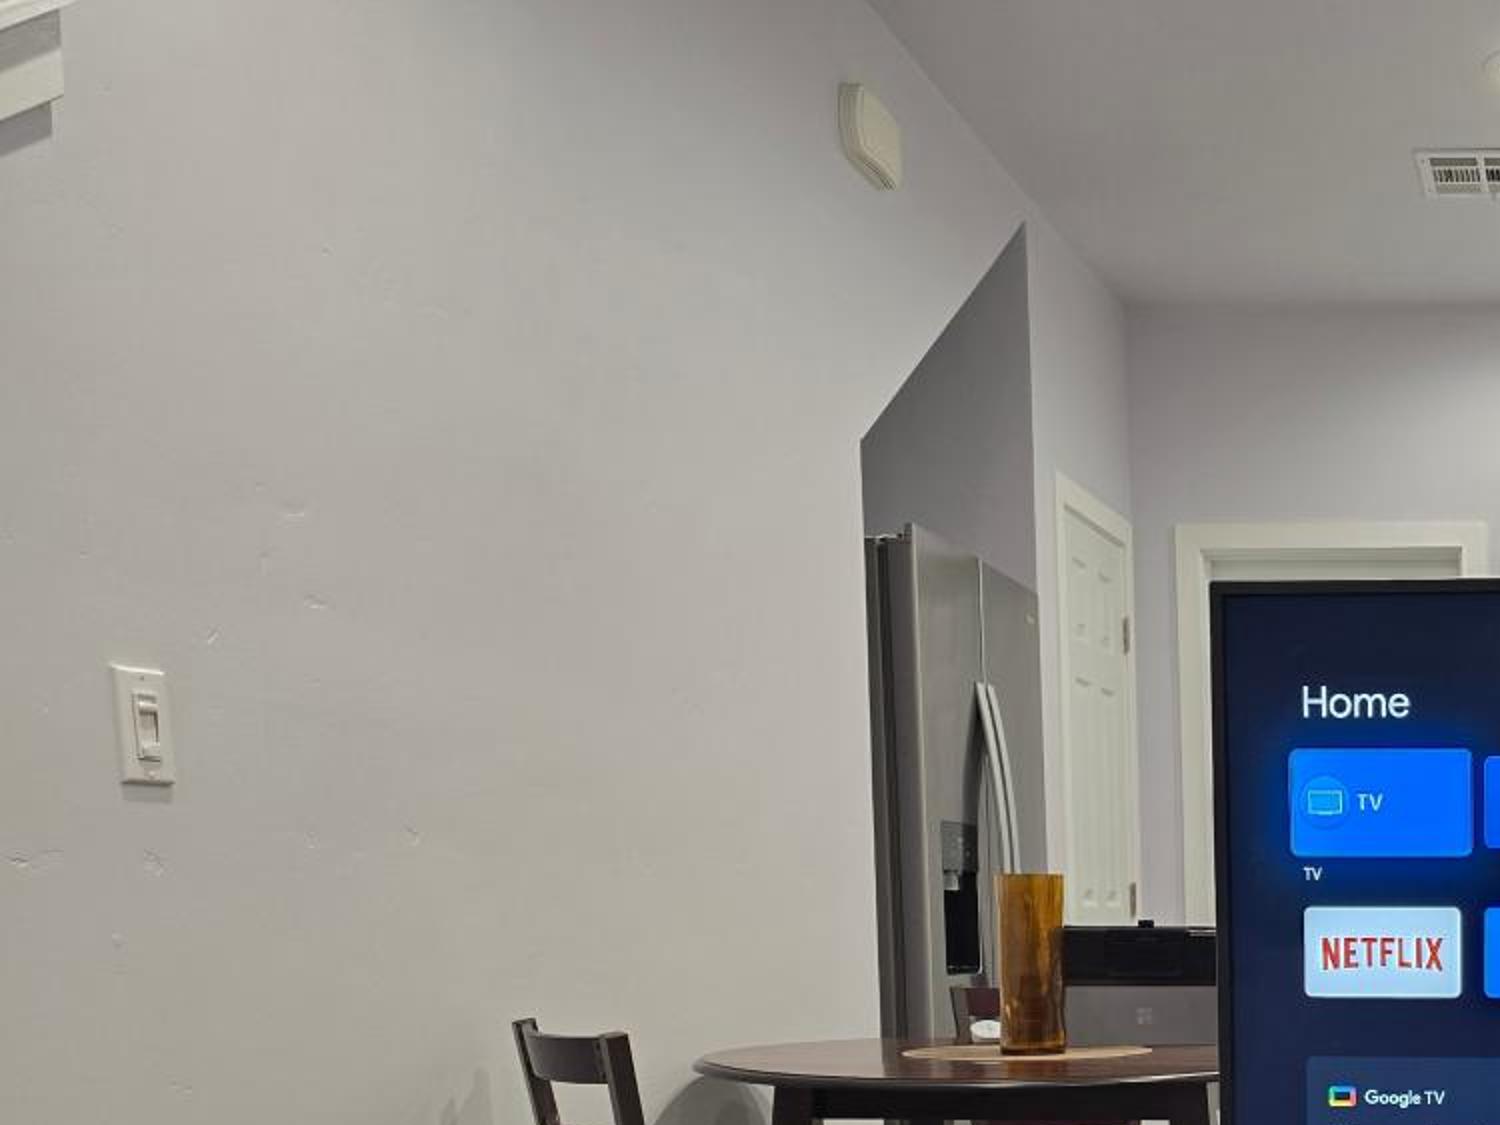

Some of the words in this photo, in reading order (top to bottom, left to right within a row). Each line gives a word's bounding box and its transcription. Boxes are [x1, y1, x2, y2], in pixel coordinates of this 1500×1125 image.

[1302, 685, 1411, 719] Home
[1358, 793, 1384, 811] TV
[1303, 866, 1322, 881] TV
[1321, 936, 1443, 971] NETFLIX
[1364, 1089, 1422, 1108] Google
[1424, 1091, 1445, 1106] TV
